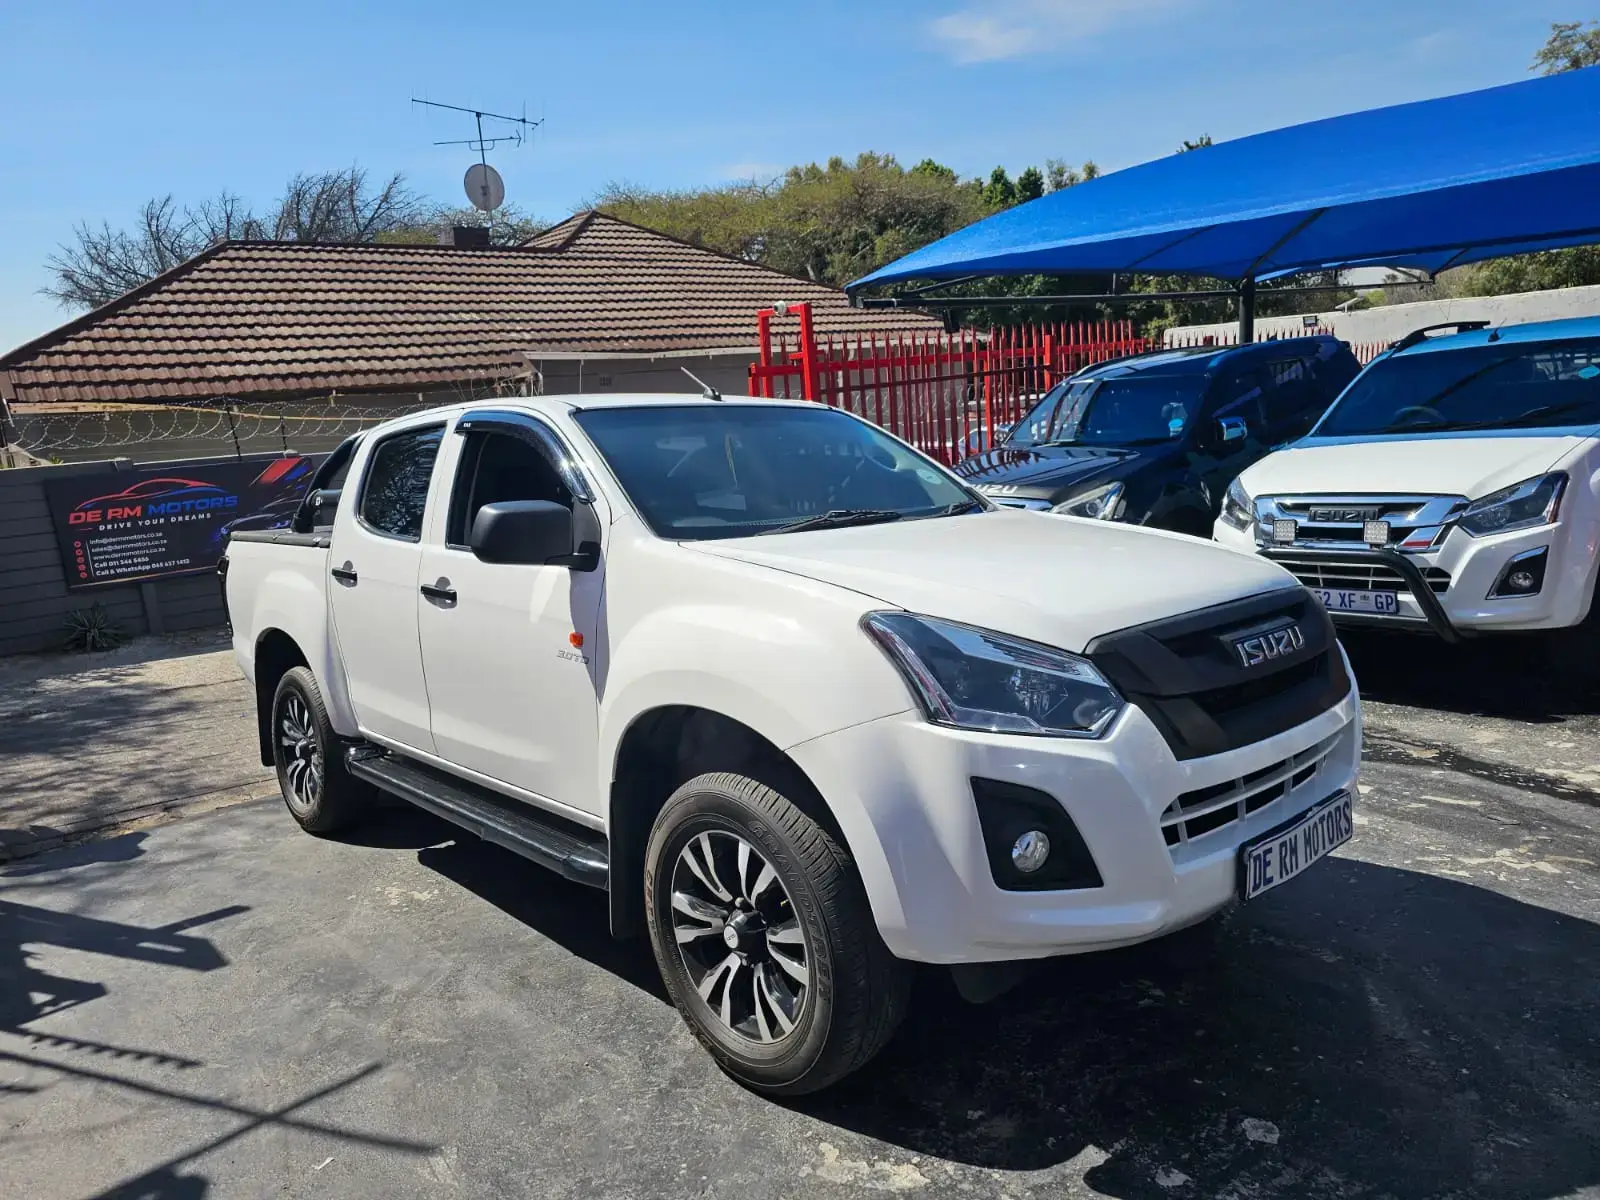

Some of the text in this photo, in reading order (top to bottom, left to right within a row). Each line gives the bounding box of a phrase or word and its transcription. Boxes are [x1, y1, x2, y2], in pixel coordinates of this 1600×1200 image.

[68, 495, 238, 525] DE RM MOTORS
[99, 512, 212, 531] DRIVE YOUR DREAMS
[96, 568, 109, 576] Call
[116, 564, 151, 574] WhatsApp
[1338, 592, 1357, 608] XF
[1374, 594, 1394, 611] GP
[1236, 625, 1304, 667] ISUZU
[1251, 803, 1352, 892] DE RM MOTORS
